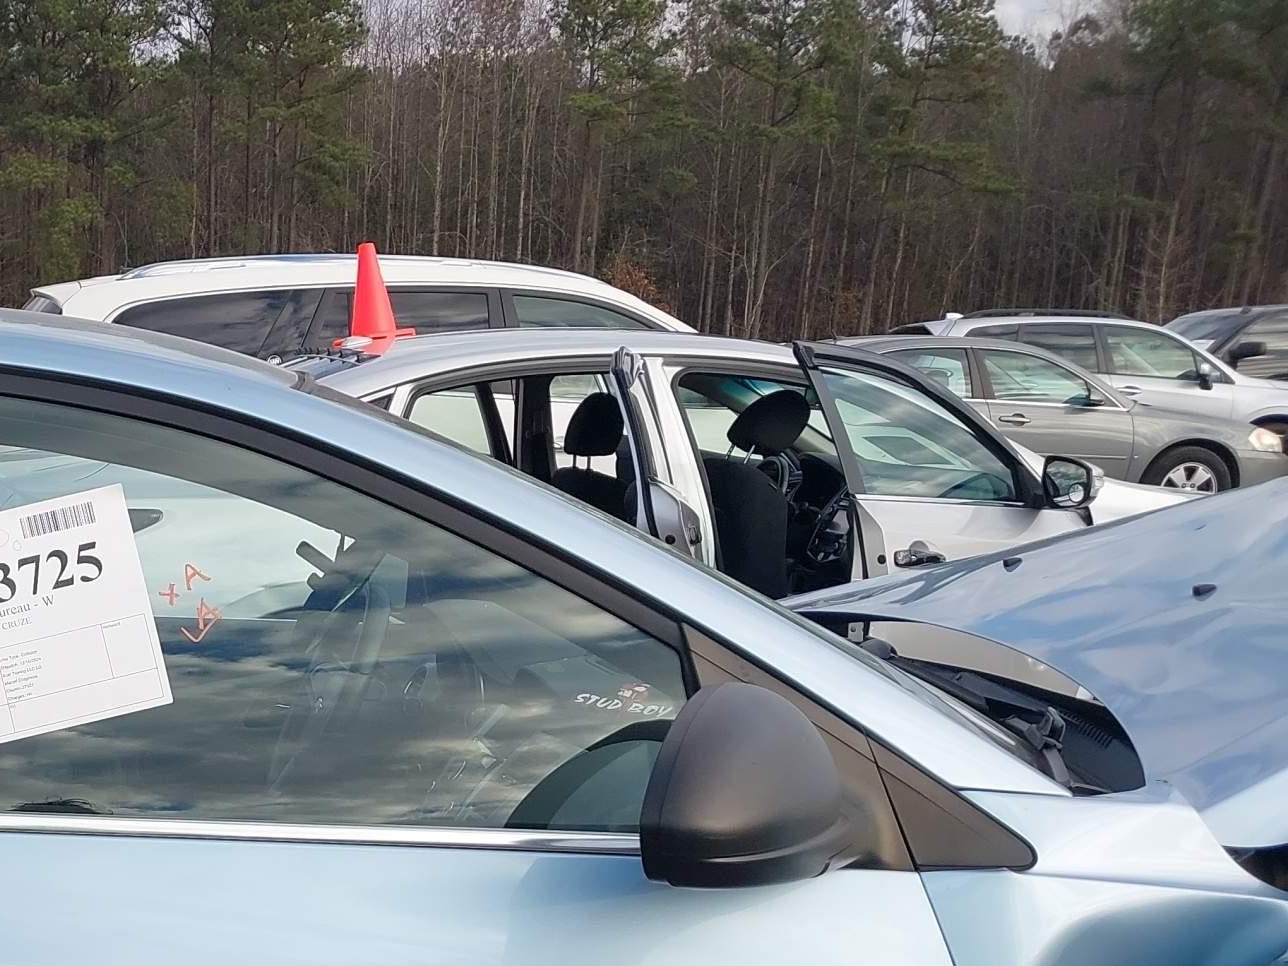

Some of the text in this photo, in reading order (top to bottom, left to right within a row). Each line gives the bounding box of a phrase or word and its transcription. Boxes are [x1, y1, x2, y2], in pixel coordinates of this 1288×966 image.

[41, 594, 56, 609] W
[1, 616, 33, 631] CRUZE
[574, 693, 673, 717] STUD BOY
